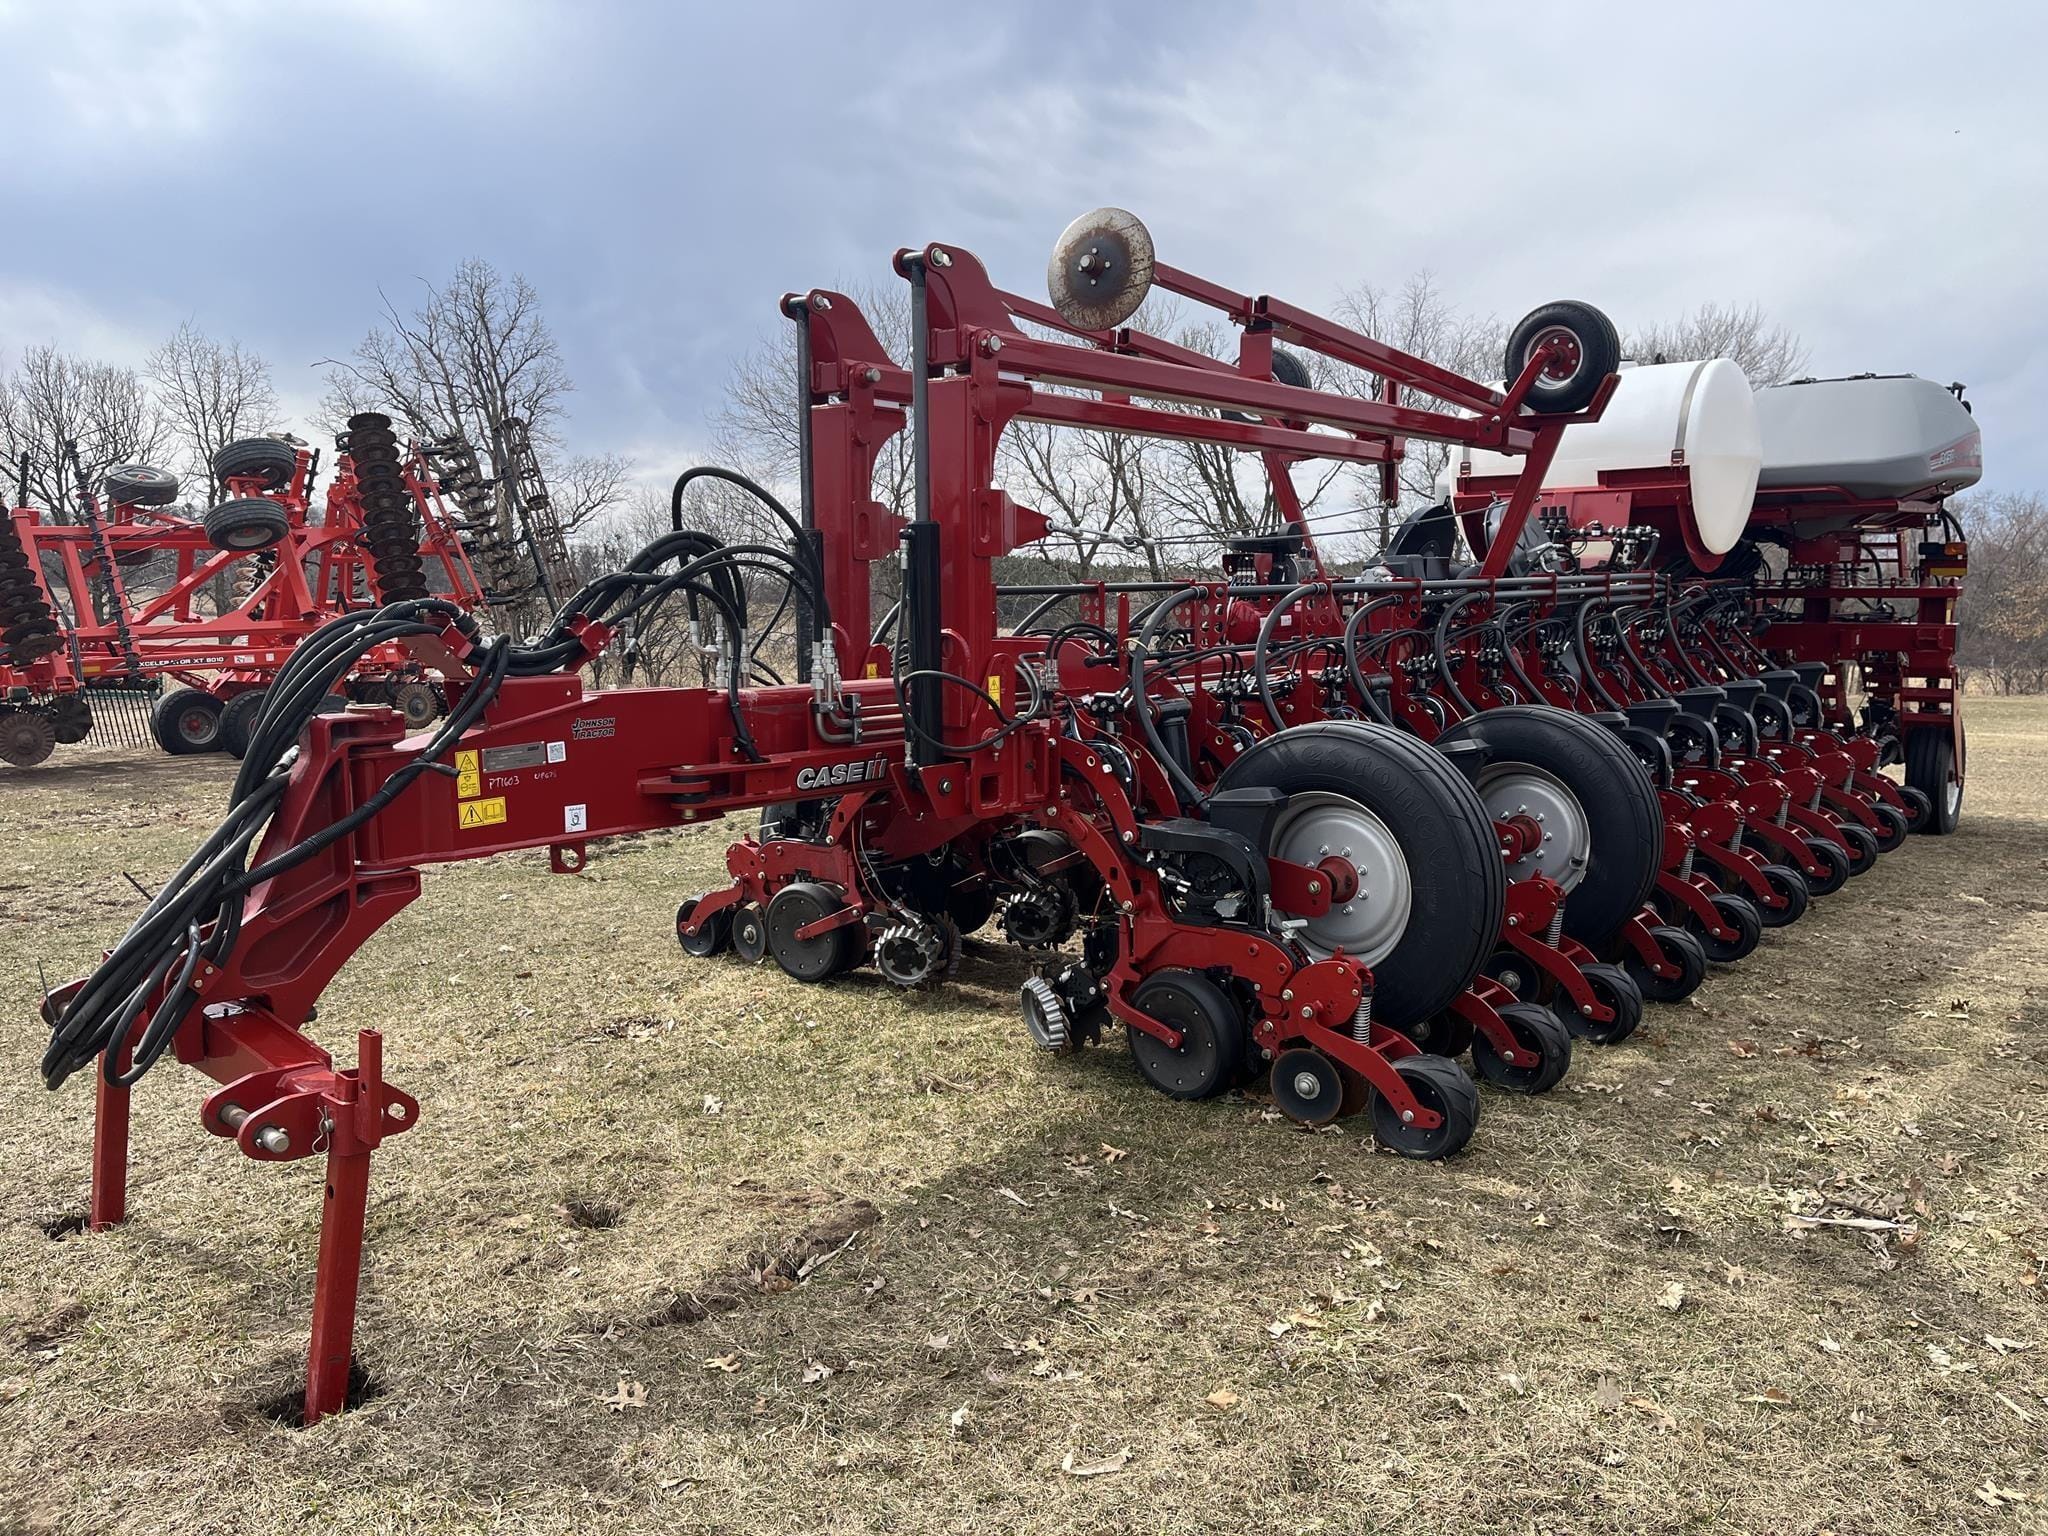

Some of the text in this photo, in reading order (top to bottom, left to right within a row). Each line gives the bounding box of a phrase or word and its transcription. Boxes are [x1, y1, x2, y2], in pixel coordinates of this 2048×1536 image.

[206, 656, 224, 664] 8010
[572, 718, 616, 730] JOHNSON
[572, 728, 616, 740] TRACTOR
[797, 761, 865, 790] CASE
